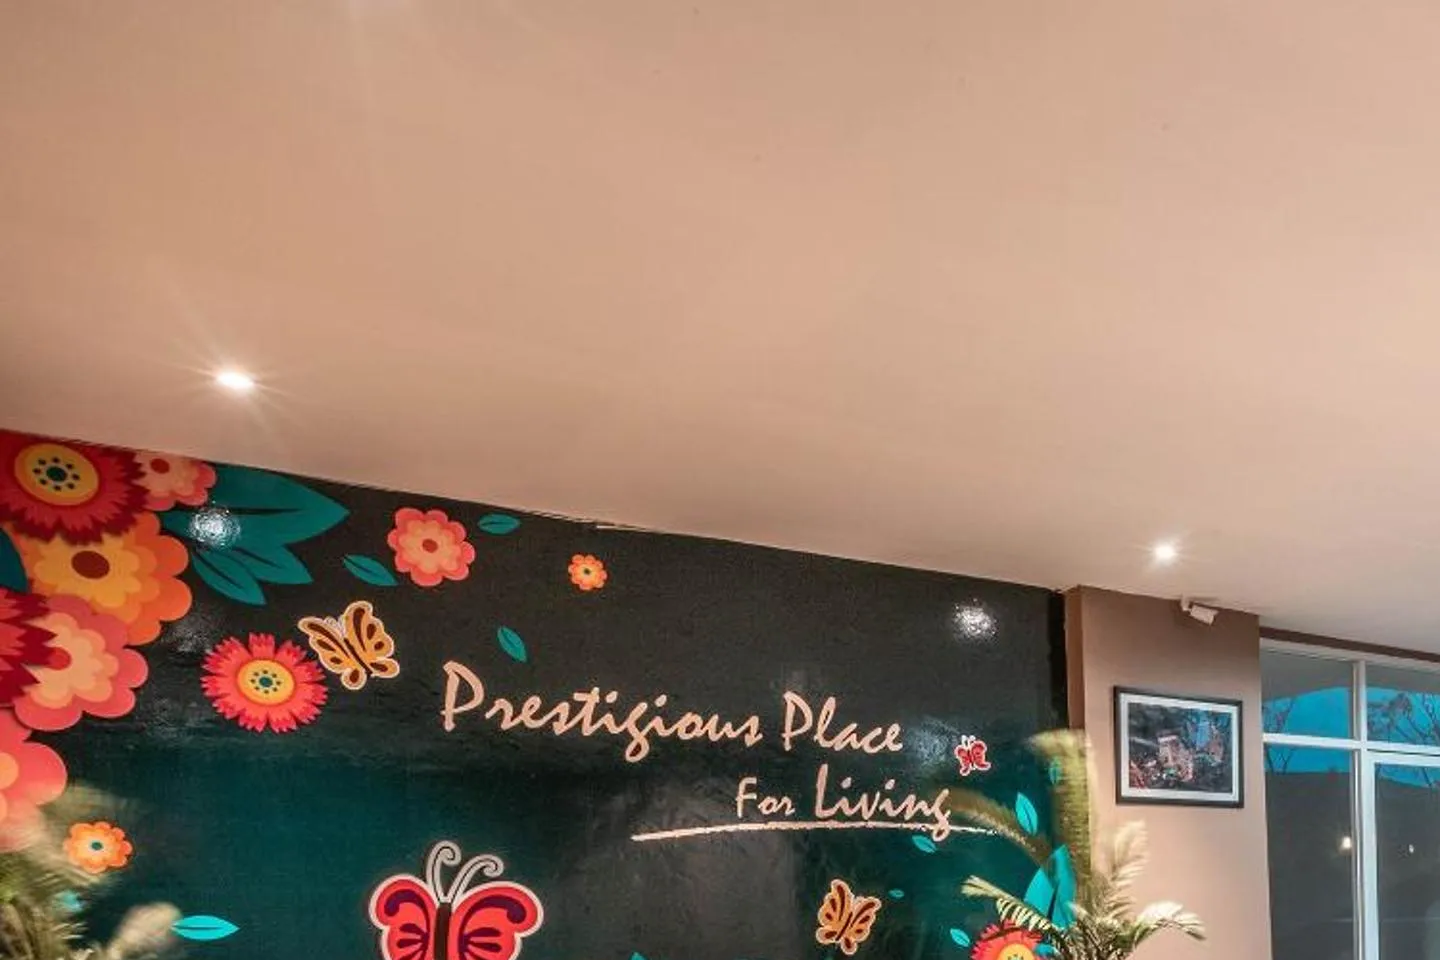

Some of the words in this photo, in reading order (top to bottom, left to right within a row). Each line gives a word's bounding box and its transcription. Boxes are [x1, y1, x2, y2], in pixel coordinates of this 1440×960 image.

[441, 660, 763, 762] Prestigious
[782, 691, 903, 754] Place
[736, 777, 796, 818] For
[815, 763, 952, 842] Living
